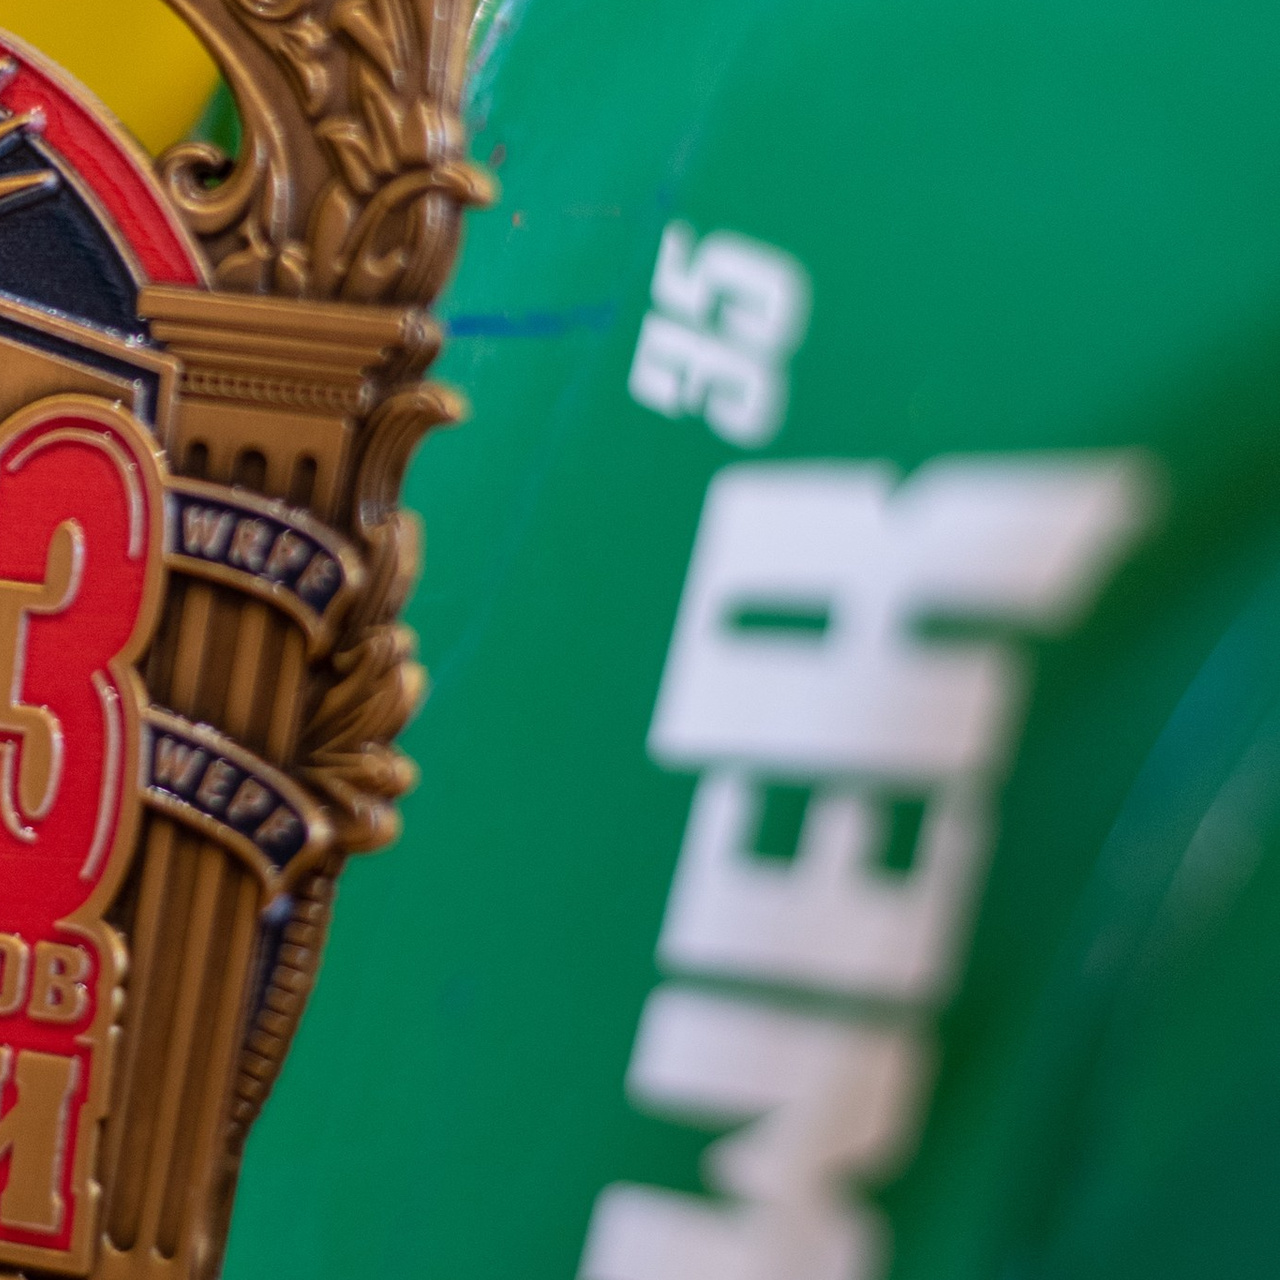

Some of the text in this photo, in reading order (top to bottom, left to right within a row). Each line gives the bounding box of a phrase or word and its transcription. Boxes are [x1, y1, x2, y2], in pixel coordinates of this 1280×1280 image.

[630, 227, 805, 442] 35
[182, 504, 342, 596] WRPF
[153, 734, 303, 843] WEPF
